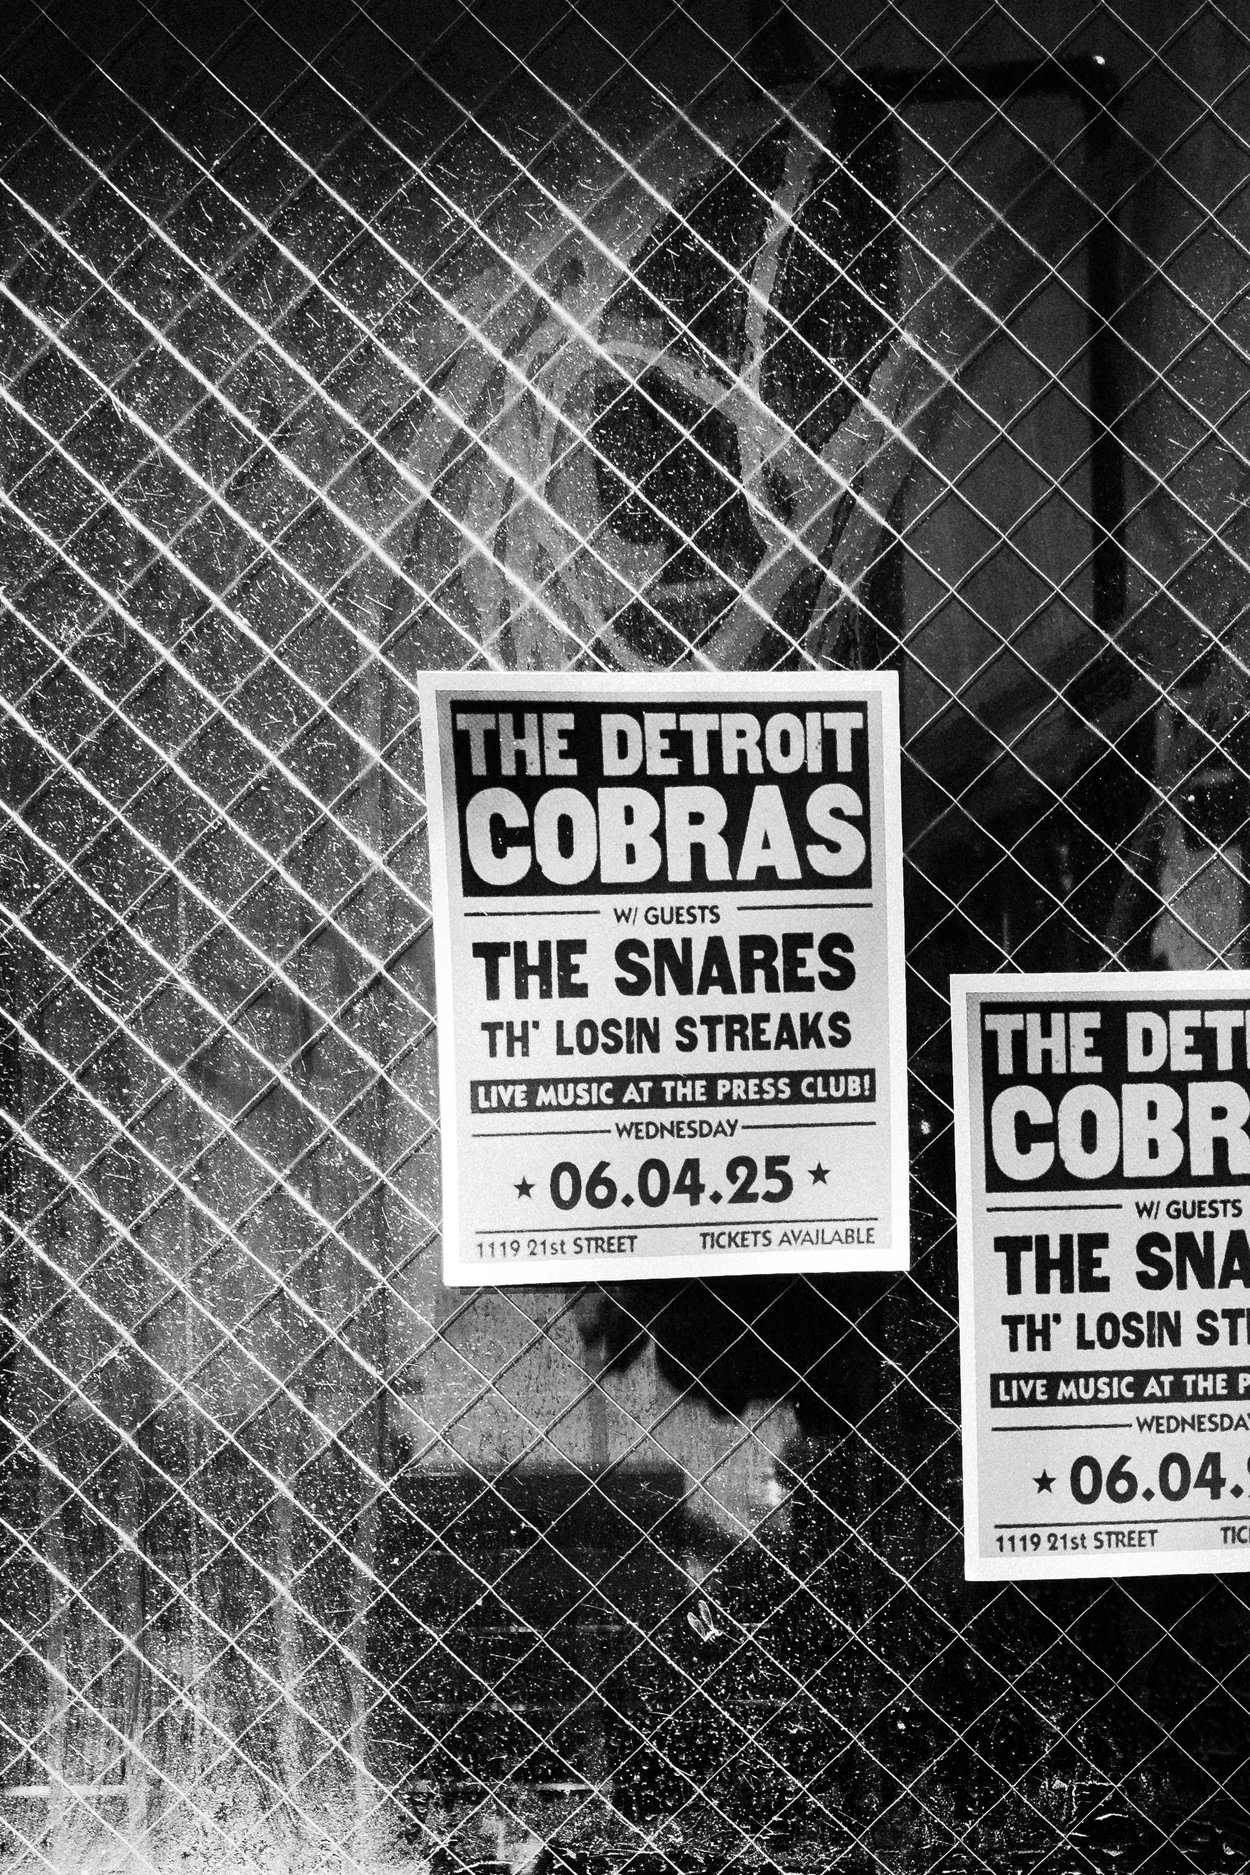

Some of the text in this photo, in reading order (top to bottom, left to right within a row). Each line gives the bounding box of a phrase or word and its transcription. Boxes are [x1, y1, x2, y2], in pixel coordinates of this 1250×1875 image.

[456, 711, 863, 776] THE DETROIT
[466, 783, 866, 886] COBRAS
[613, 905, 721, 925] W/ GUESTS
[472, 932, 856, 1001] THE SNARES
[481, 1011, 851, 1058] TH' LOSIN STREAKS
[985, 1012, 1102, 1075] THE
[478, 1075, 870, 1108] LIVE MUSIC AT THE PRESS CLUB!
[615, 1119, 738, 1140] WEDNESDAY
[550, 1155, 793, 1210] 06.04.25
[1135, 1199, 1243, 1220] W/ GUESTS
[477, 1235, 638, 1258] 1119 21st STREET
[699, 1227, 875, 1250] TICKETS AVAILABLE
[994, 1232, 1110, 1295] THE
[1001, 1313, 1061, 1352] TH'
[1076, 1310, 1181, 1350] LOSIN
[999, 1379, 1048, 1401] LIVE
[1057, 1376, 1134, 1400] MUSIC
[1143, 1375, 1174, 1397] AT
[1182, 1373, 1228, 1396] THE
[996, 1529, 1158, 1553] 1119 21st STREET
